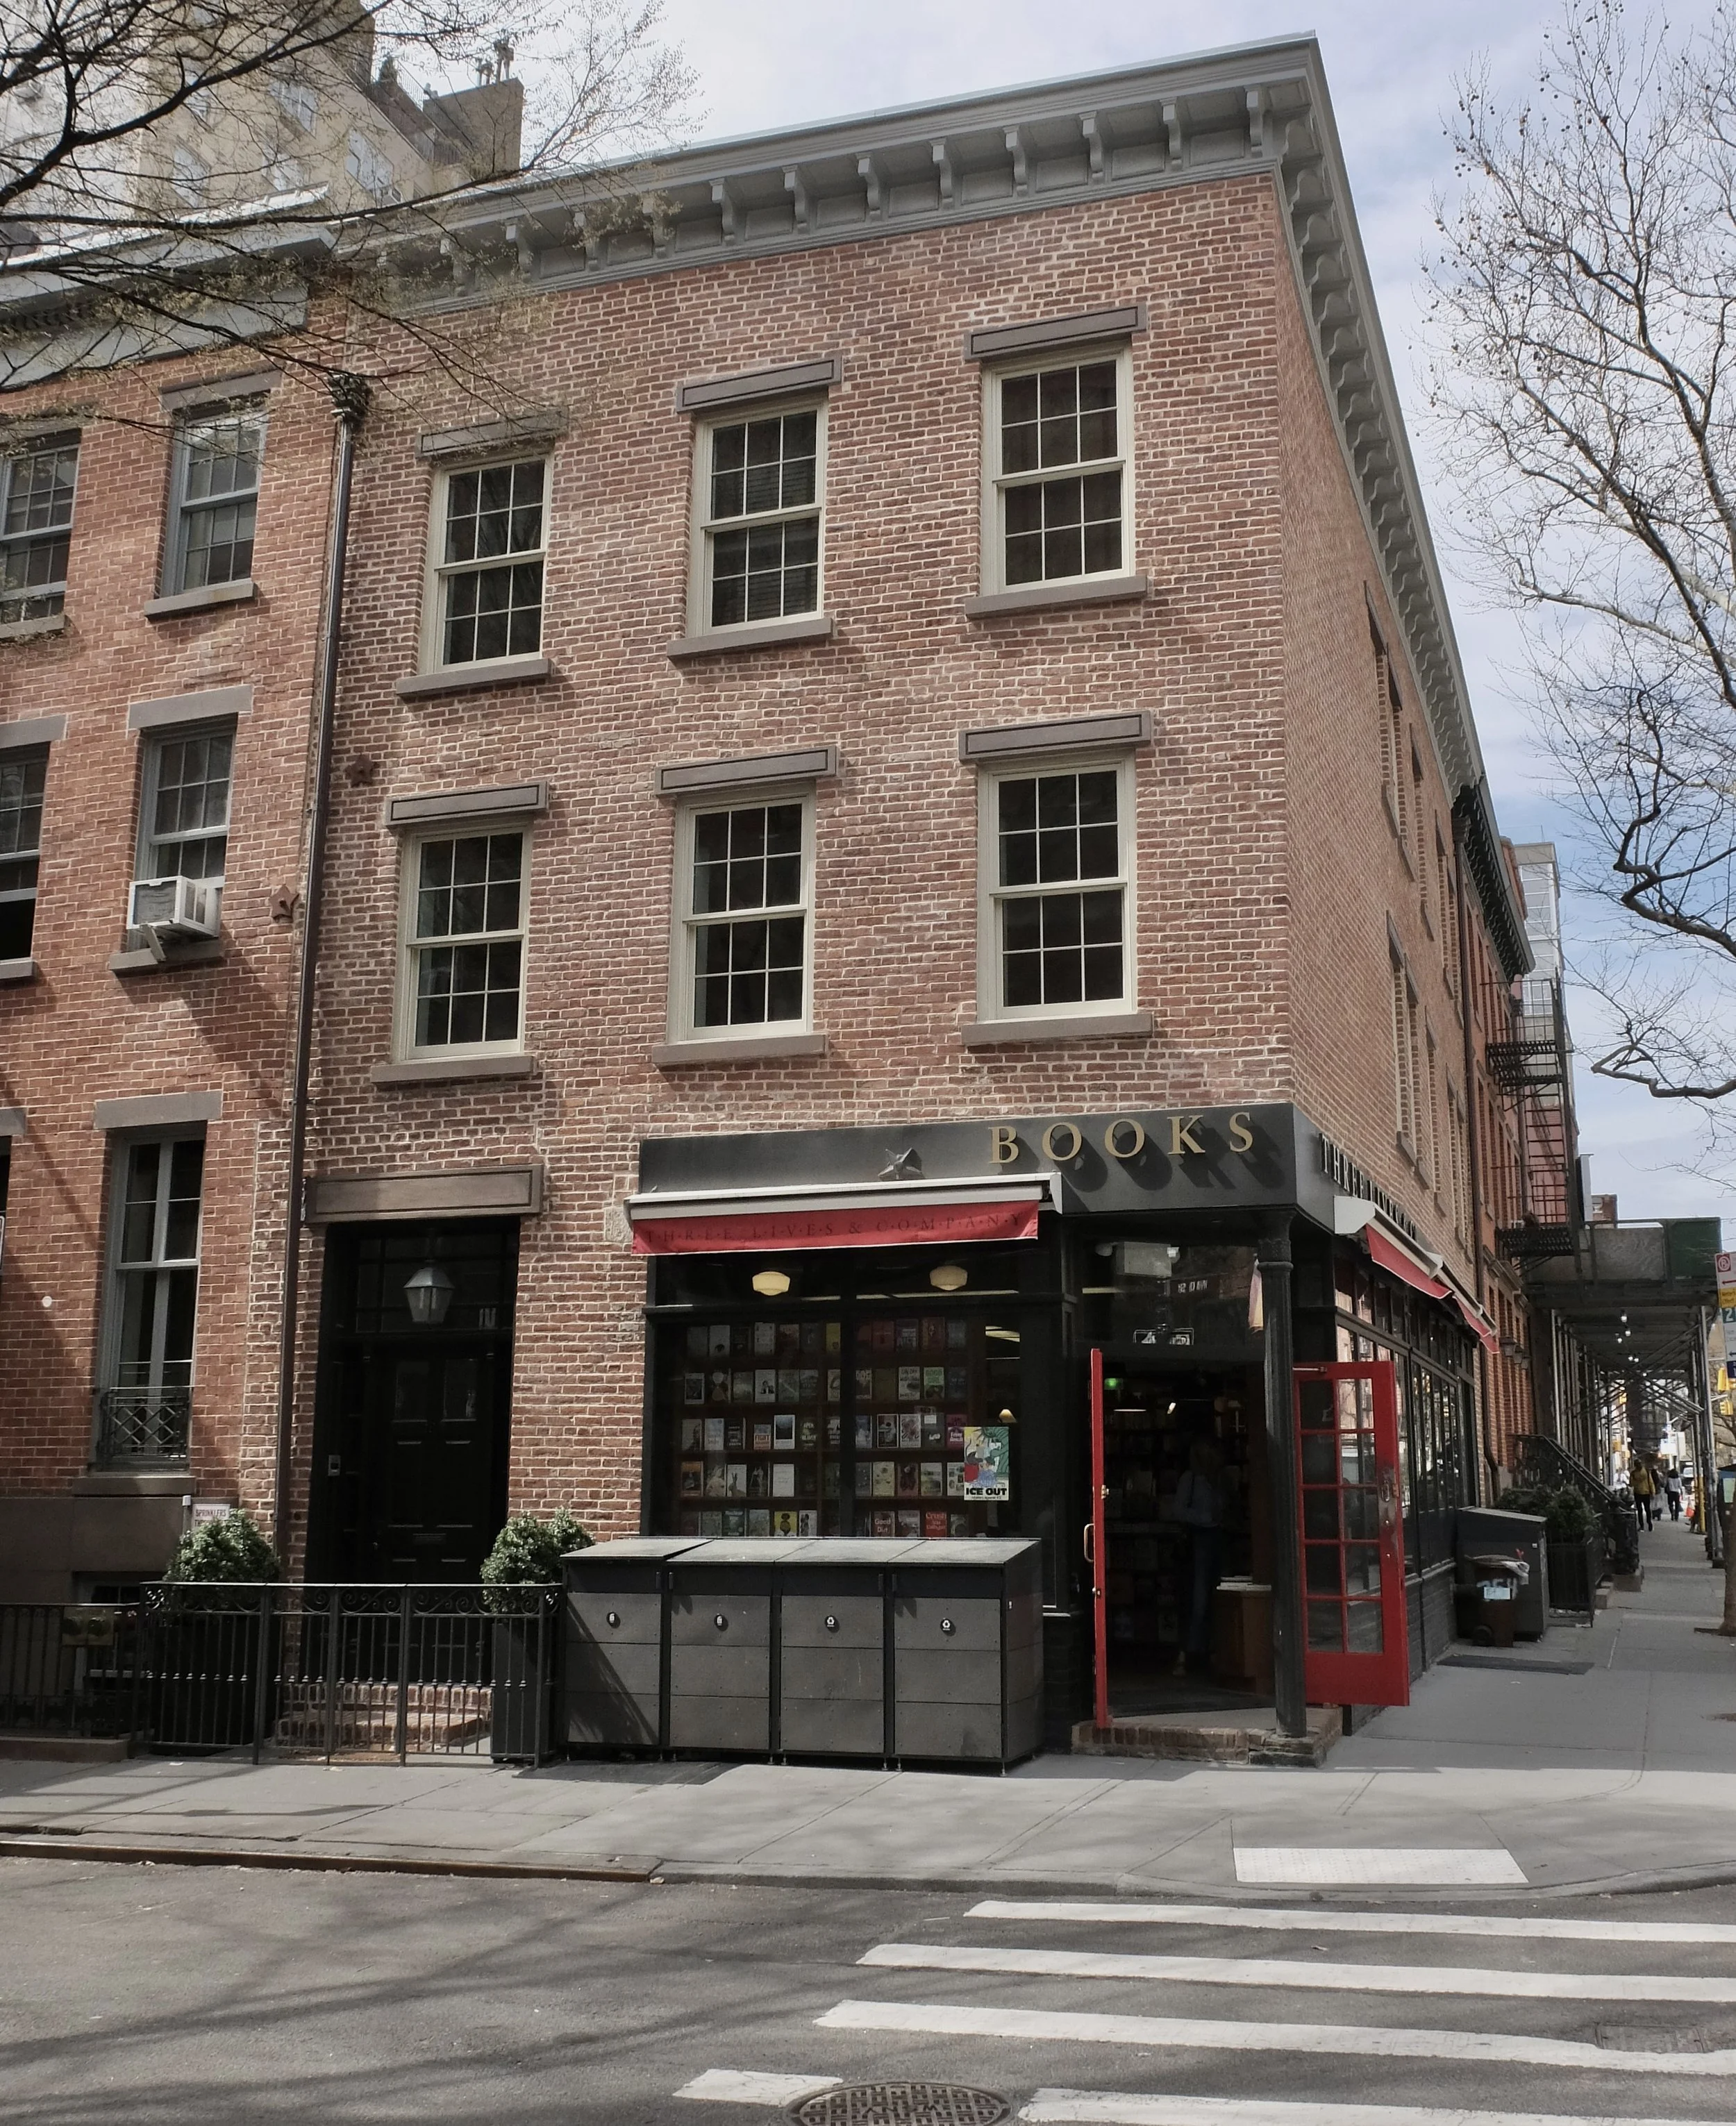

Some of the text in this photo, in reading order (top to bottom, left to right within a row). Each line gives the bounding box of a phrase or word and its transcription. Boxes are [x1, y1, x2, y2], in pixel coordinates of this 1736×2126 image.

[988, 1112, 1254, 1164] BOOKS
[849, 1221, 860, 1234] &
[196, 1509, 226, 1517] SPRINKLERS
